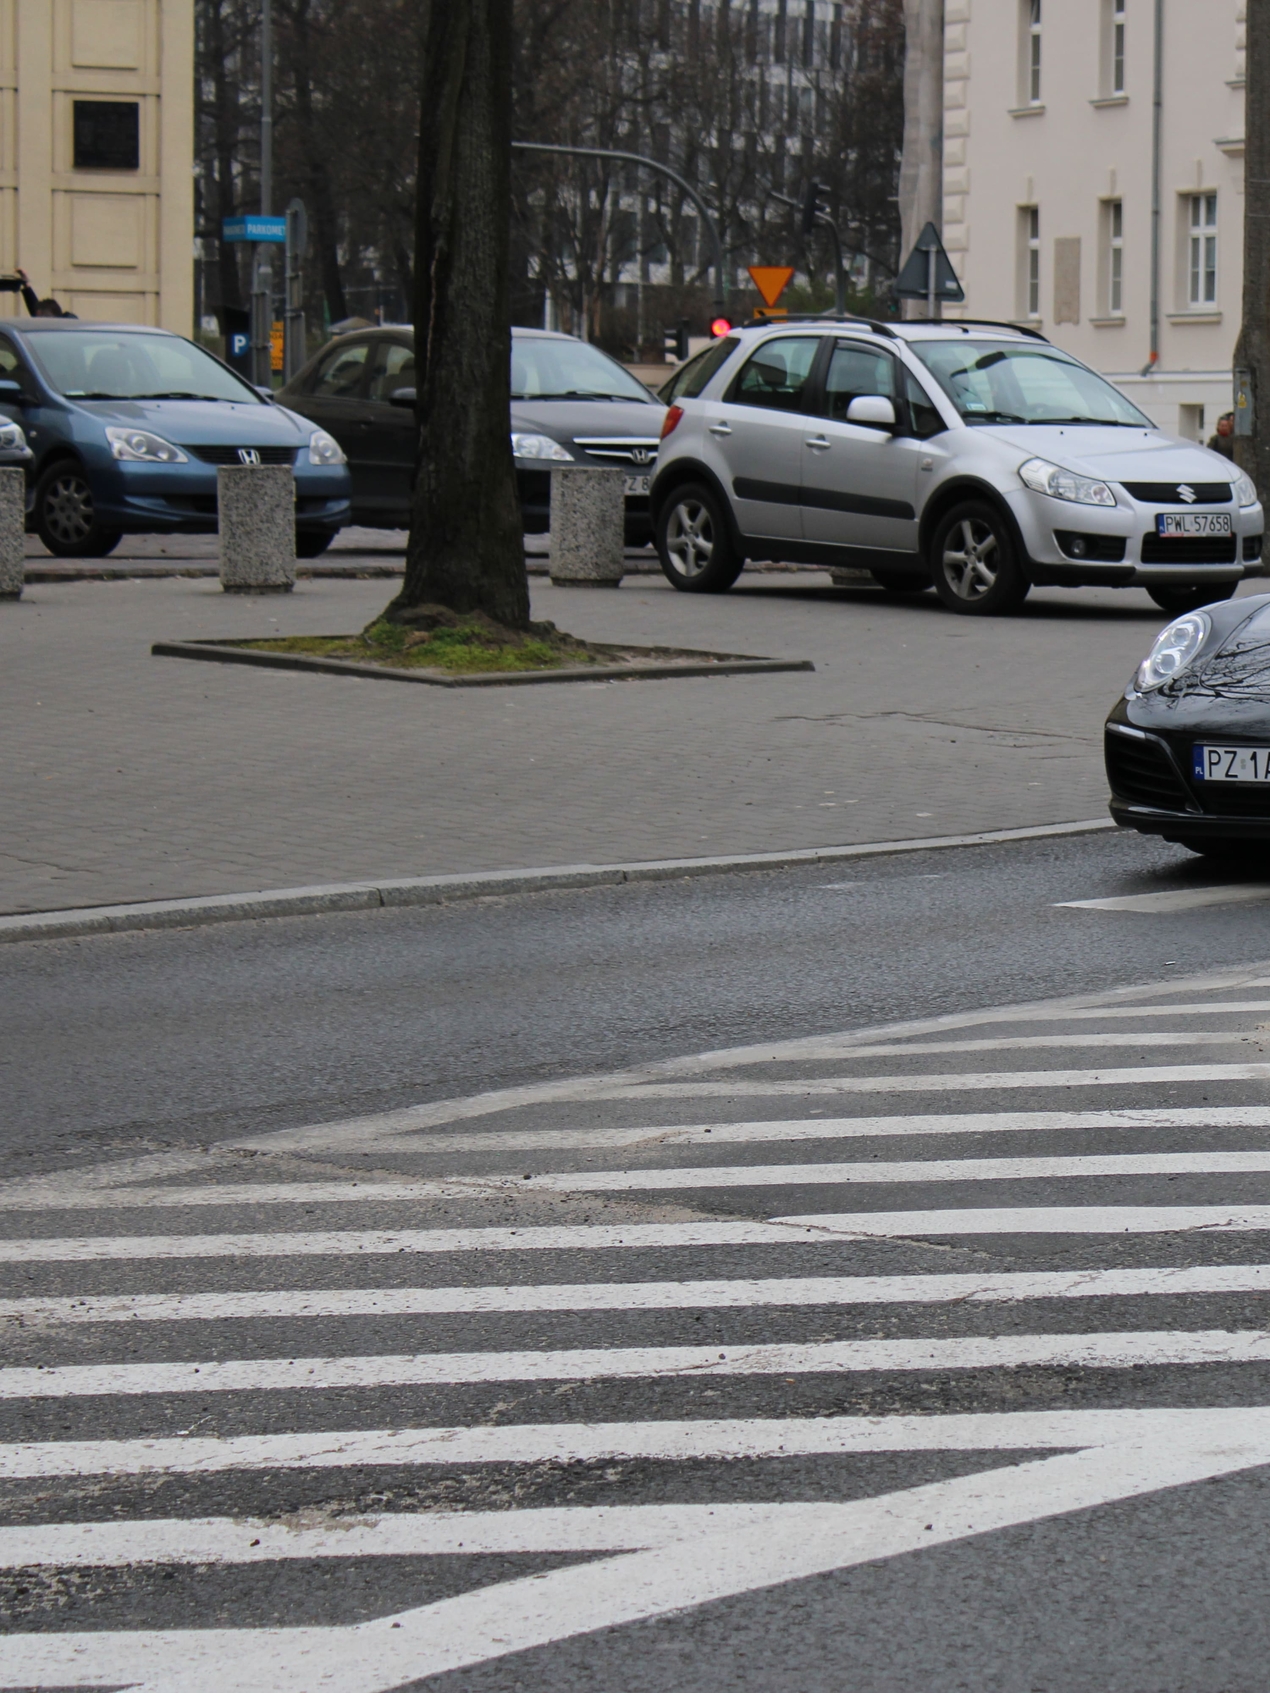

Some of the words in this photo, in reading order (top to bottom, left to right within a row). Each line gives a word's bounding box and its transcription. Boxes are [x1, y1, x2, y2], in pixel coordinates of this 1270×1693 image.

[233, 334, 246, 353] P
[1165, 515, 1190, 532] PWL
[1193, 515, 1229, 532] 57658
[1195, 766, 1203, 775] PL
[1208, 749, 1238, 778] PZ
